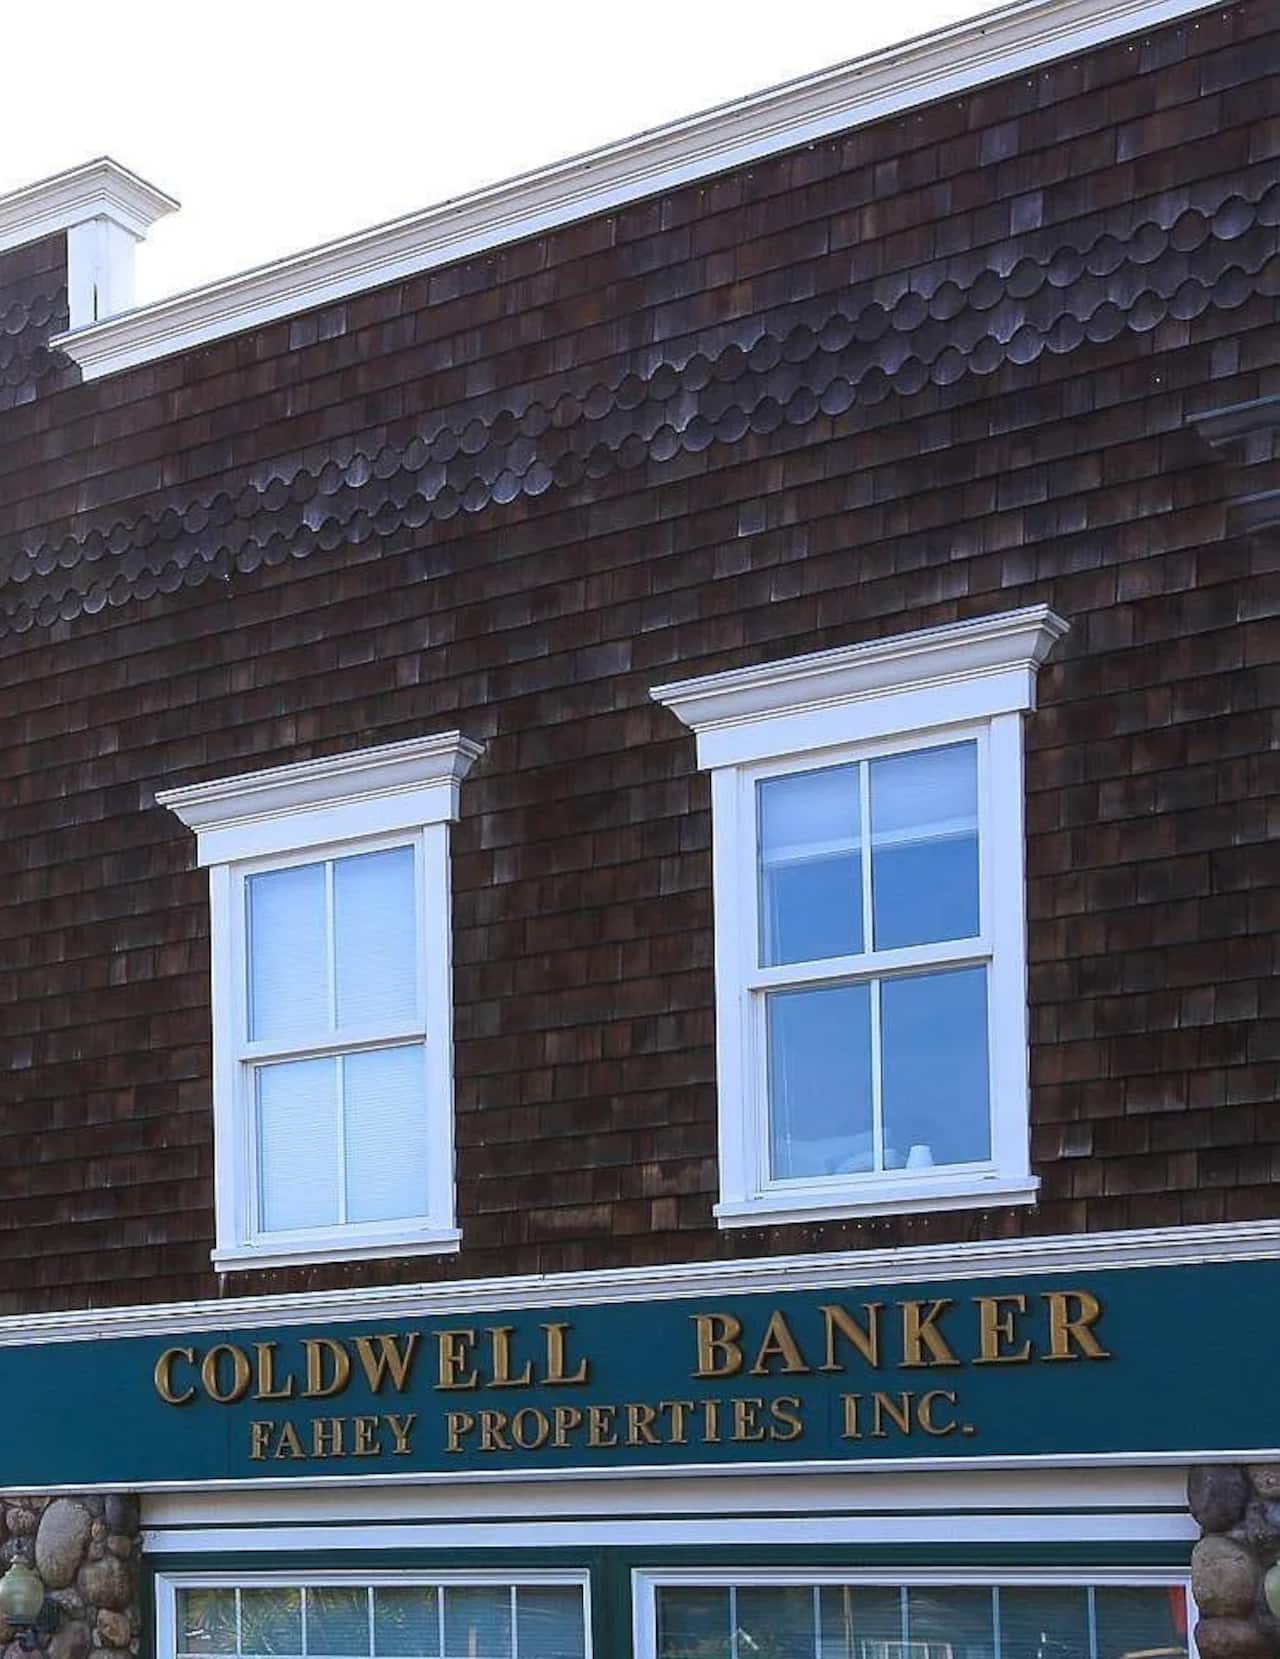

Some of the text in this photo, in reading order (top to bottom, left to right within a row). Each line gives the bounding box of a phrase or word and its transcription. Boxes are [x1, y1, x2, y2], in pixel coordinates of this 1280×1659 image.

[152, 1290, 1110, 1404] COLDWELL BANKER
[248, 1389, 976, 1460] FAHEY PROPERTIES INC.
